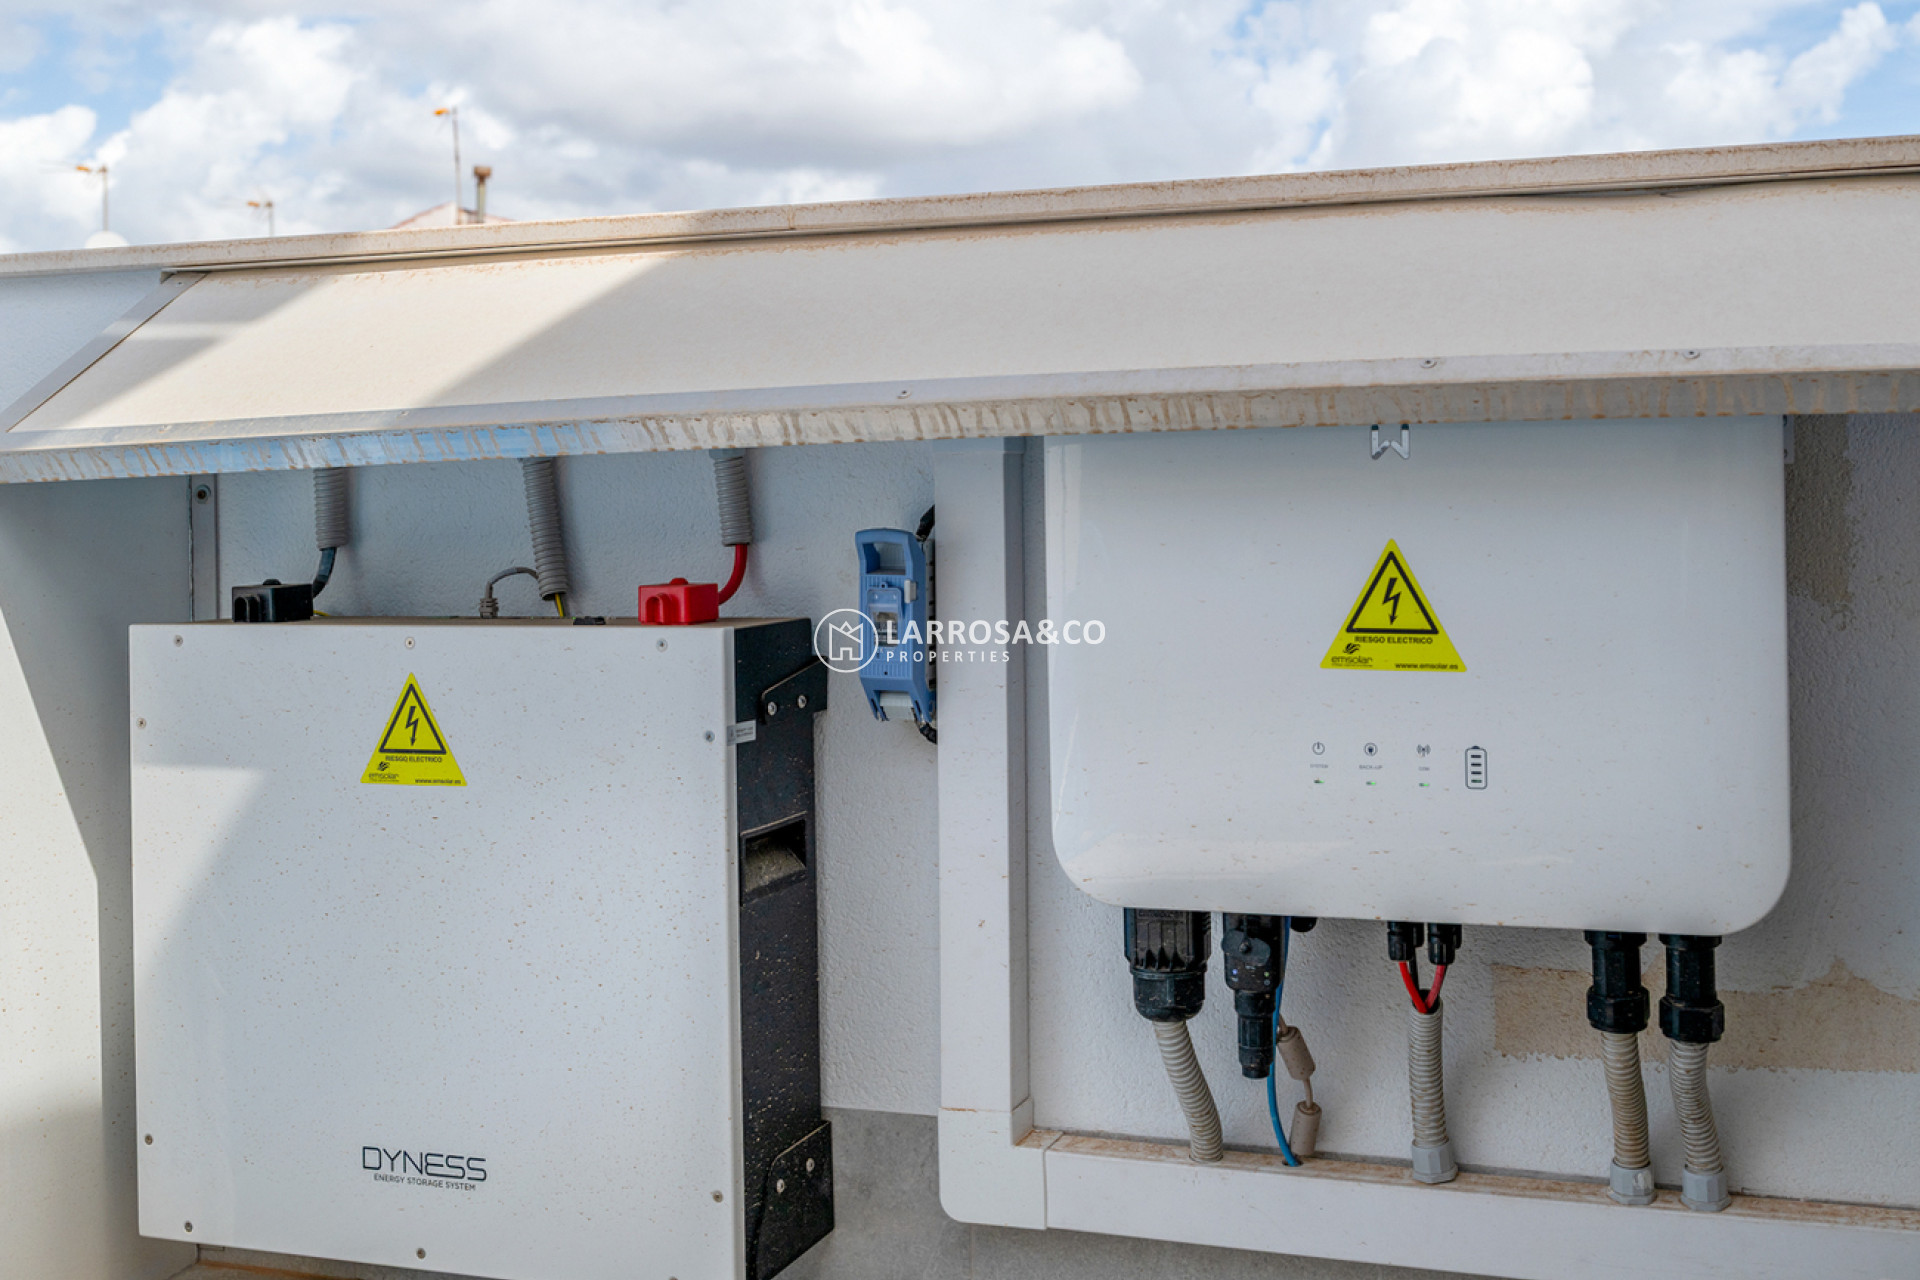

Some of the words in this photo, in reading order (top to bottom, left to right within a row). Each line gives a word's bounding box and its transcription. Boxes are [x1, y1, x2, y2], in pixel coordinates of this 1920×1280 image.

[1387, 636, 1433, 644] ELECTRICO
[1331, 655, 1373, 664] emsolar
[385, 755, 408, 763] RIESGO
[362, 1146, 487, 1182] DYNESS
[373, 1173, 405, 1184] ENERGY
[407, 1177, 444, 1188] STORAGE
[445, 1181, 477, 1191] SYSTEM
